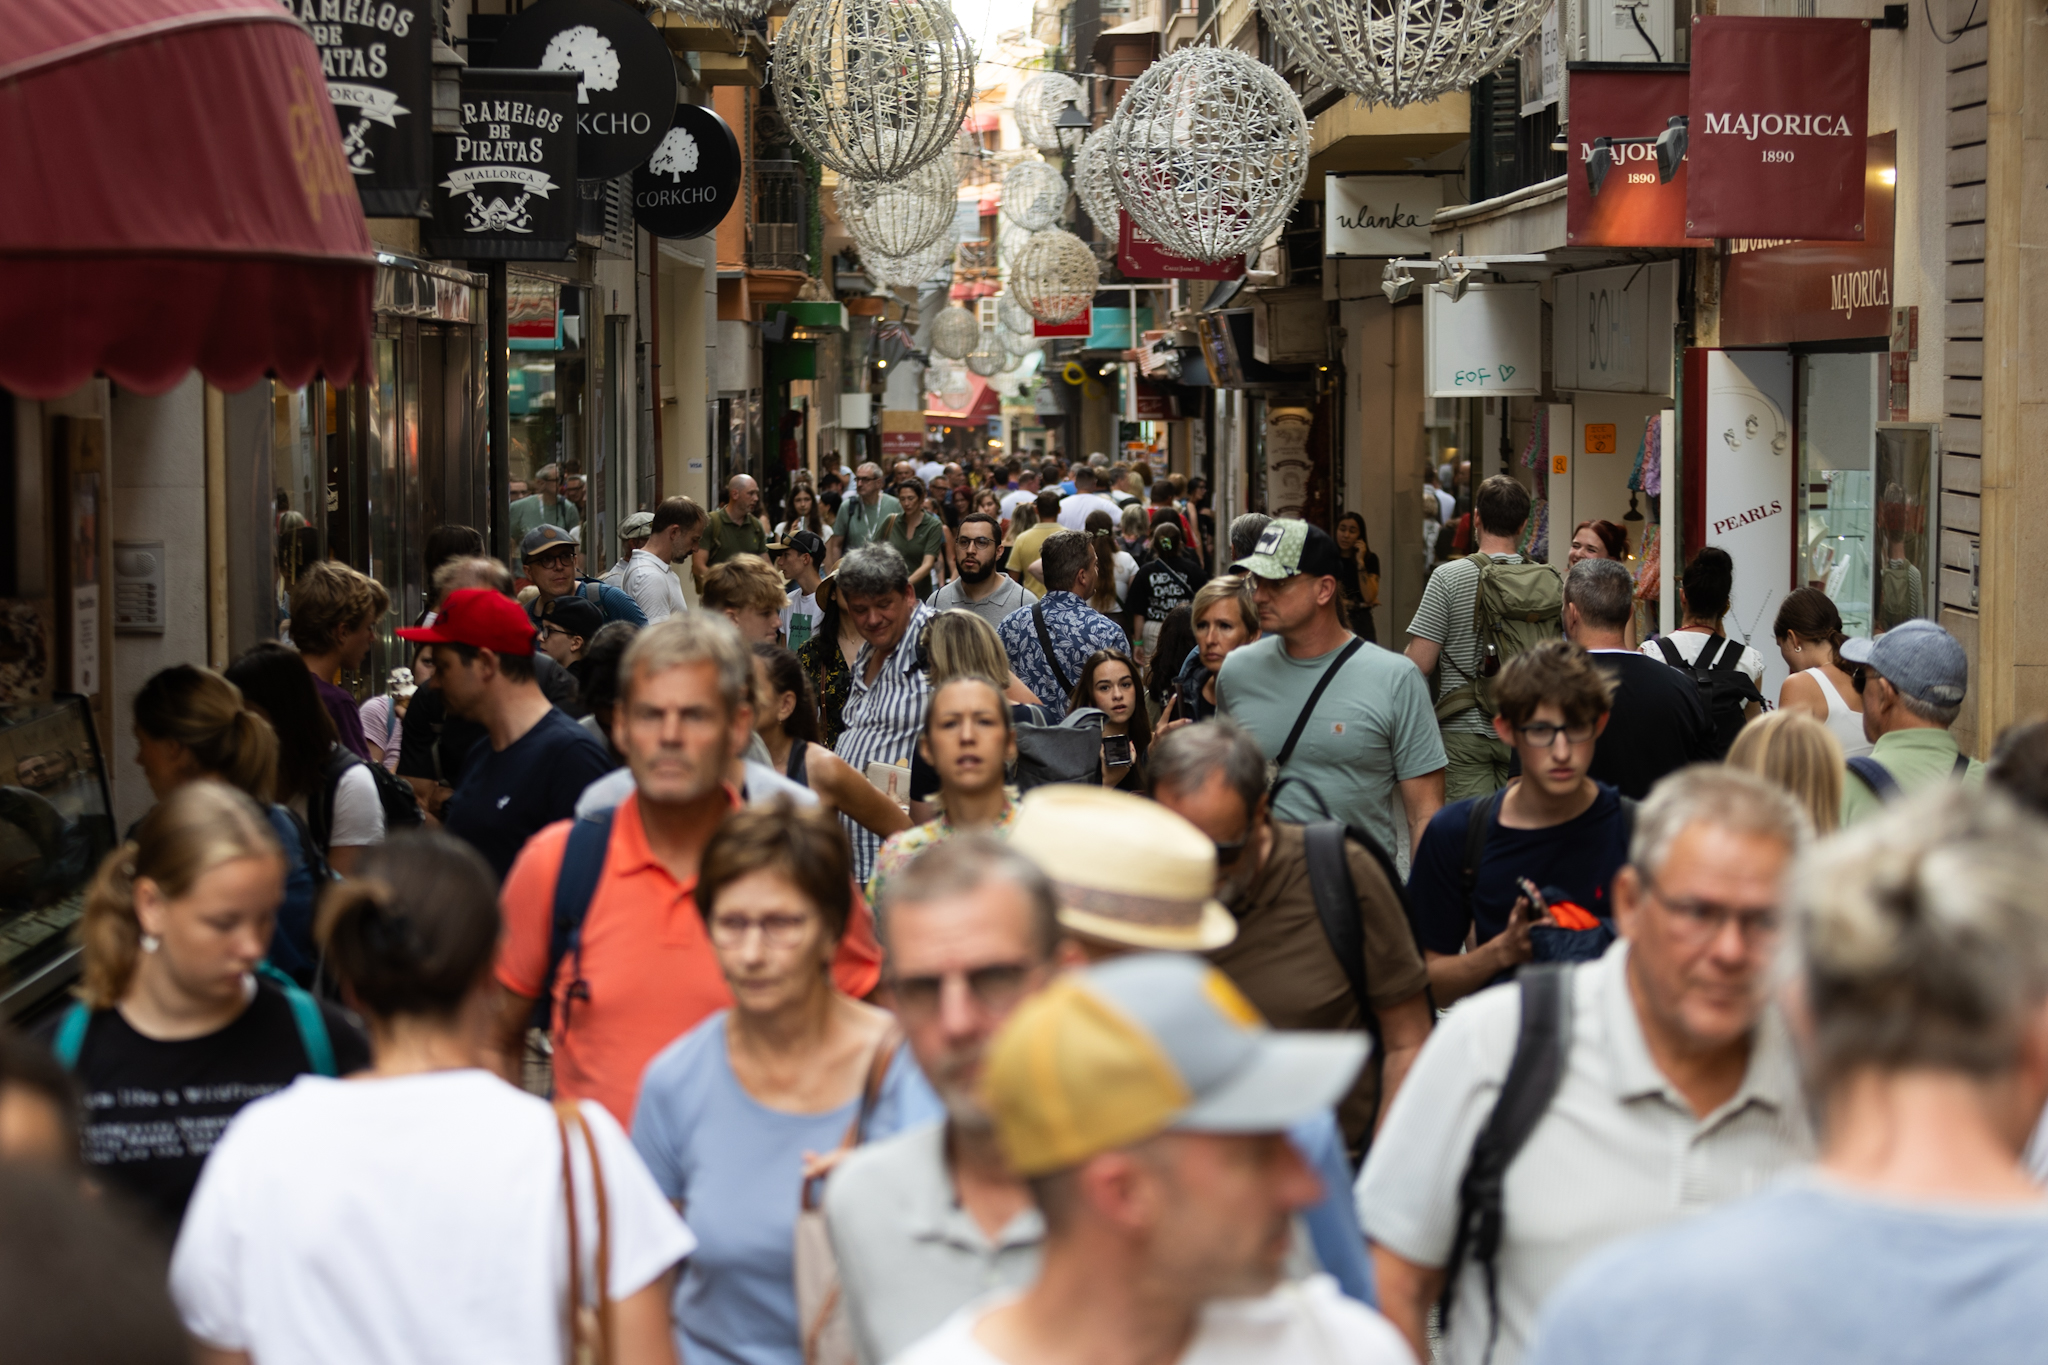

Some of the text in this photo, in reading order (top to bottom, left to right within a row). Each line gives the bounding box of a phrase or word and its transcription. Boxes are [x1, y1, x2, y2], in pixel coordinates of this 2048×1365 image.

[313, 24, 343, 46] DE
[321, 43, 388, 79] ATAS
[328, 88, 376, 105] ORCA
[461, 100, 563, 133] RAMELOS
[576, 112, 651, 135] KCHO
[1703, 112, 1853, 141] MAJORICA
[488, 124, 511, 140] DE
[455, 136, 544, 163] PIRATAS
[1761, 150, 1795, 163] 1890
[464, 168, 535, 183] MALLORCA
[1627, 173, 1656, 184] 1890
[636, 185, 717, 208] CORKCHO
[1336, 203, 1432, 229] ulanka
[1830, 268, 1890, 320] MAJORICA
[1712, 500, 1783, 535] PEARLS
